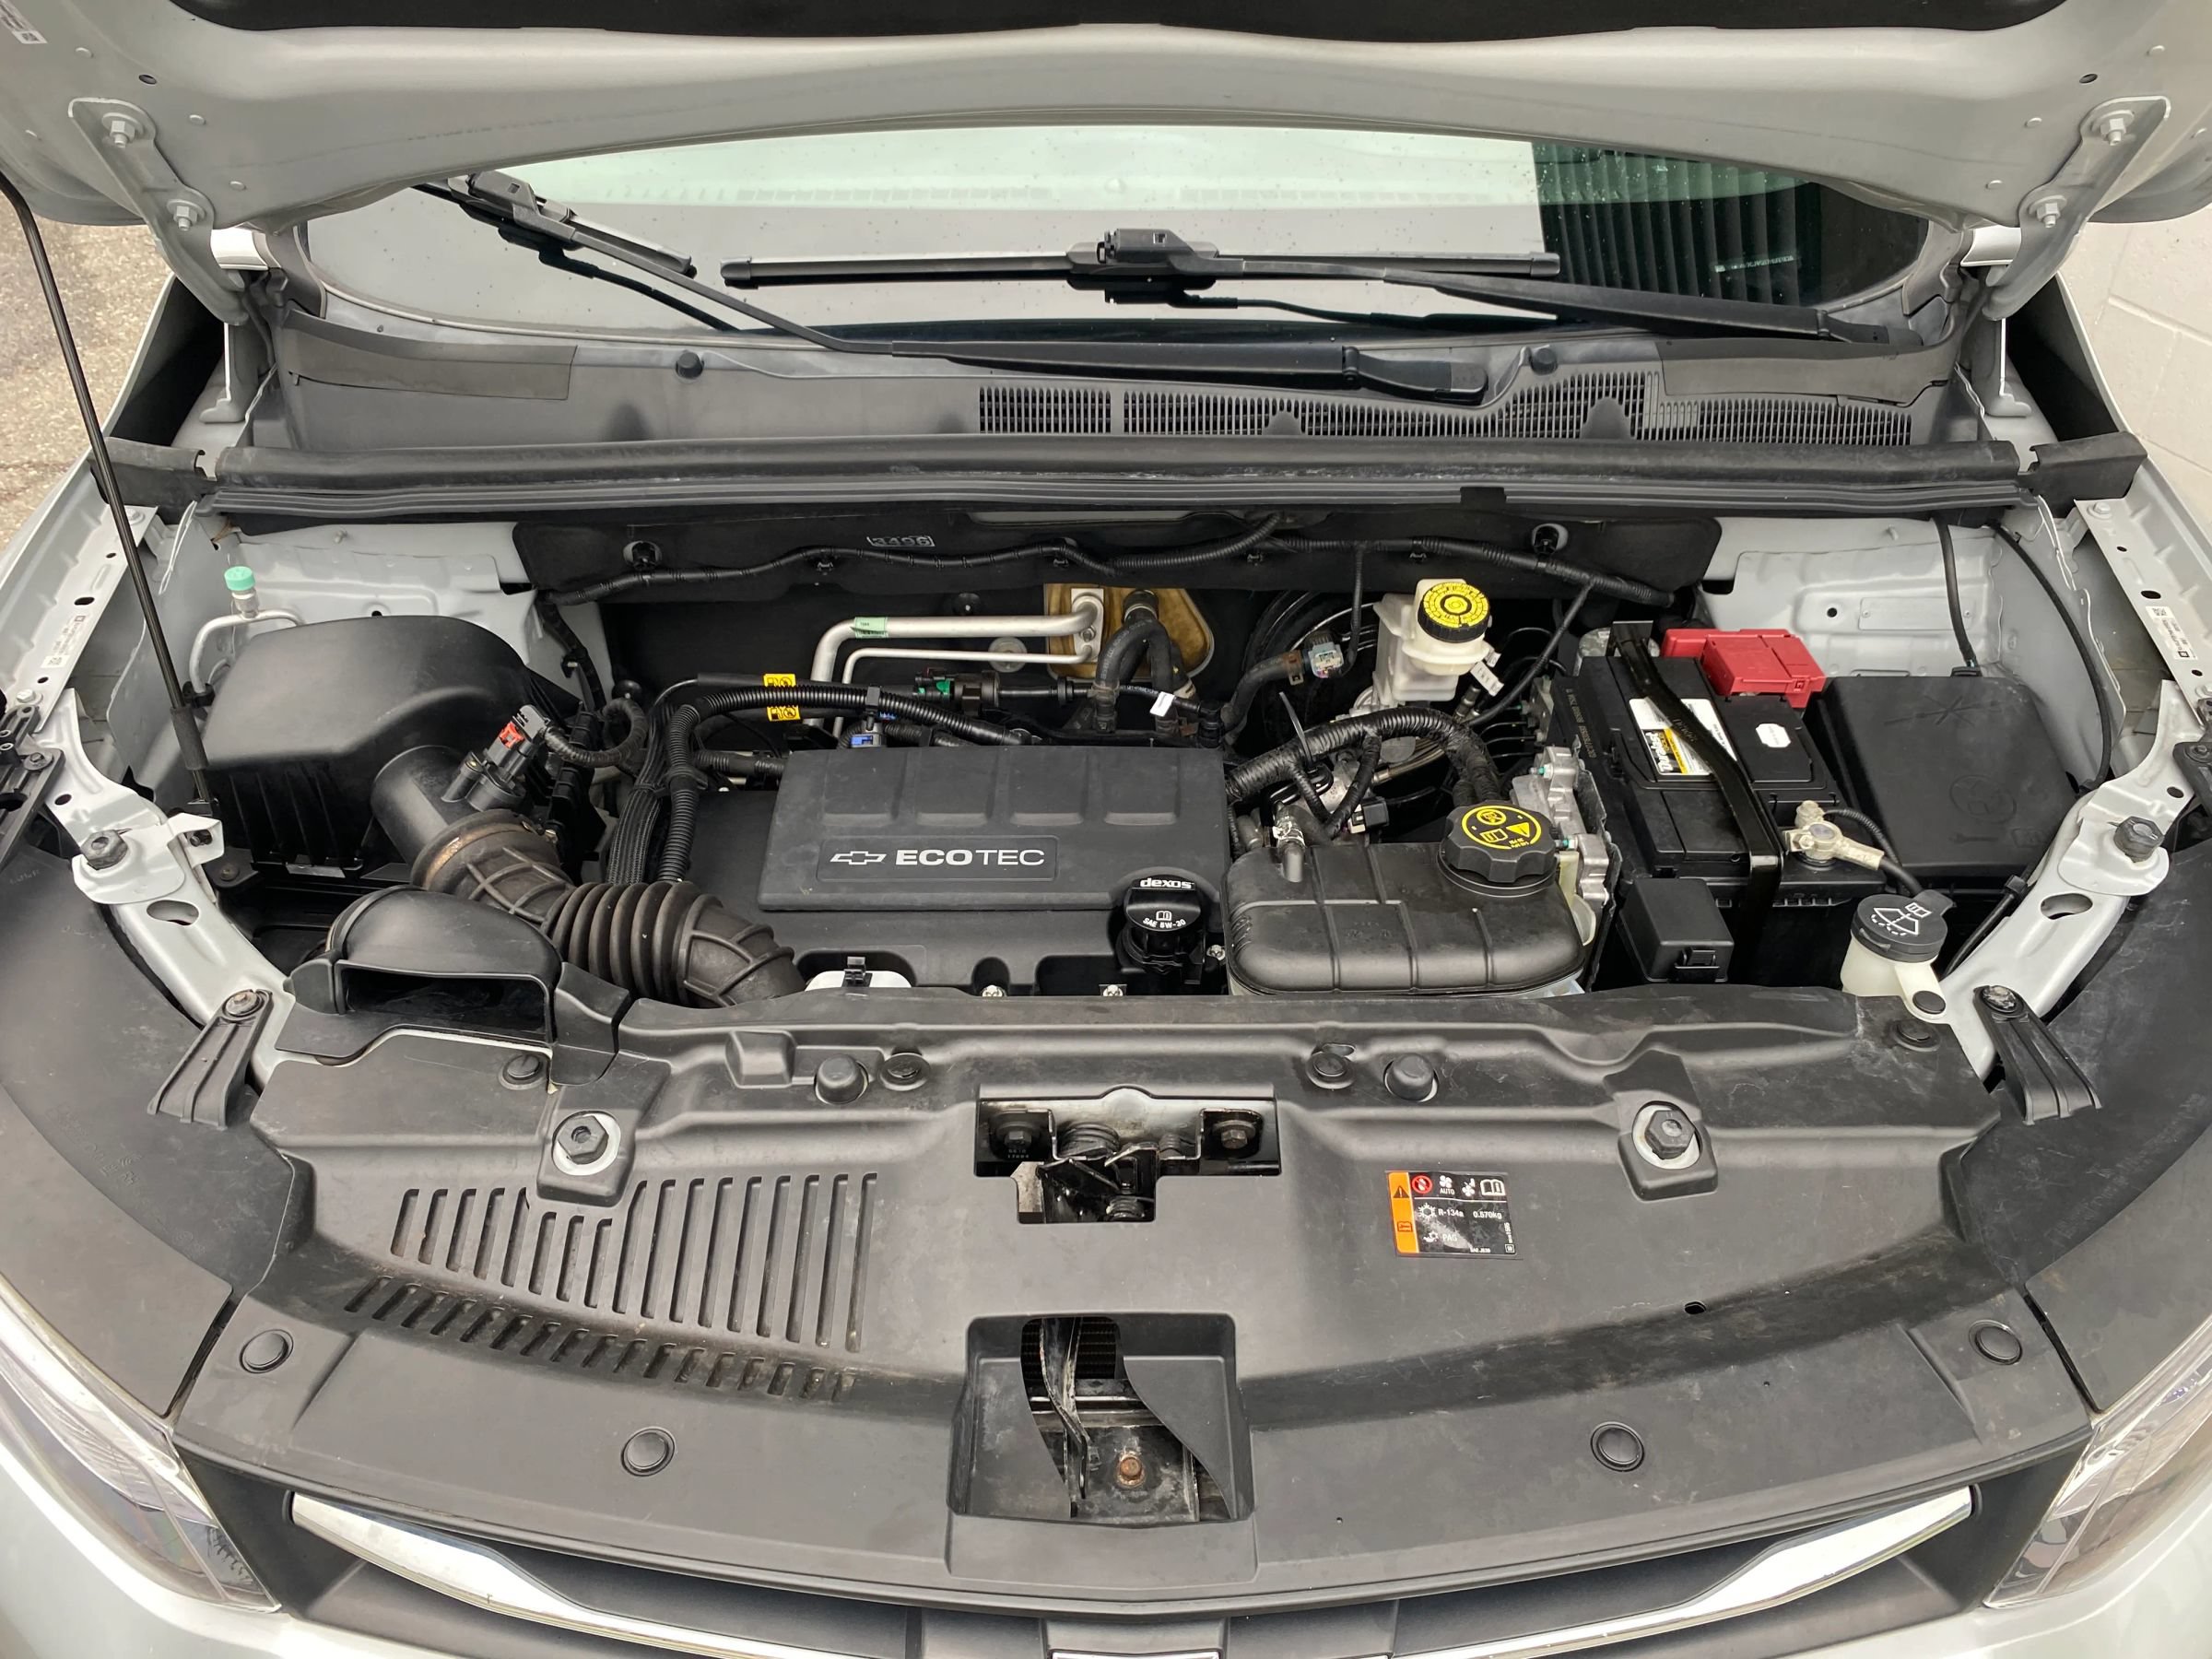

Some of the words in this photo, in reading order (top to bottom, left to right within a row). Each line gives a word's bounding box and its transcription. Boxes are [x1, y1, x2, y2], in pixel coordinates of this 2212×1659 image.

[895, 849, 1045, 866] ECOTEC
[1139, 877, 1193, 889] dexos
[1143, 917, 1158, 928] SAE
[1159, 918, 1186, 929] 5W-30
[1438, 1208, 1465, 1218] R-134a
[1473, 1211, 1502, 1219] 0.570kg
[1442, 1234, 1458, 1242] PAG
